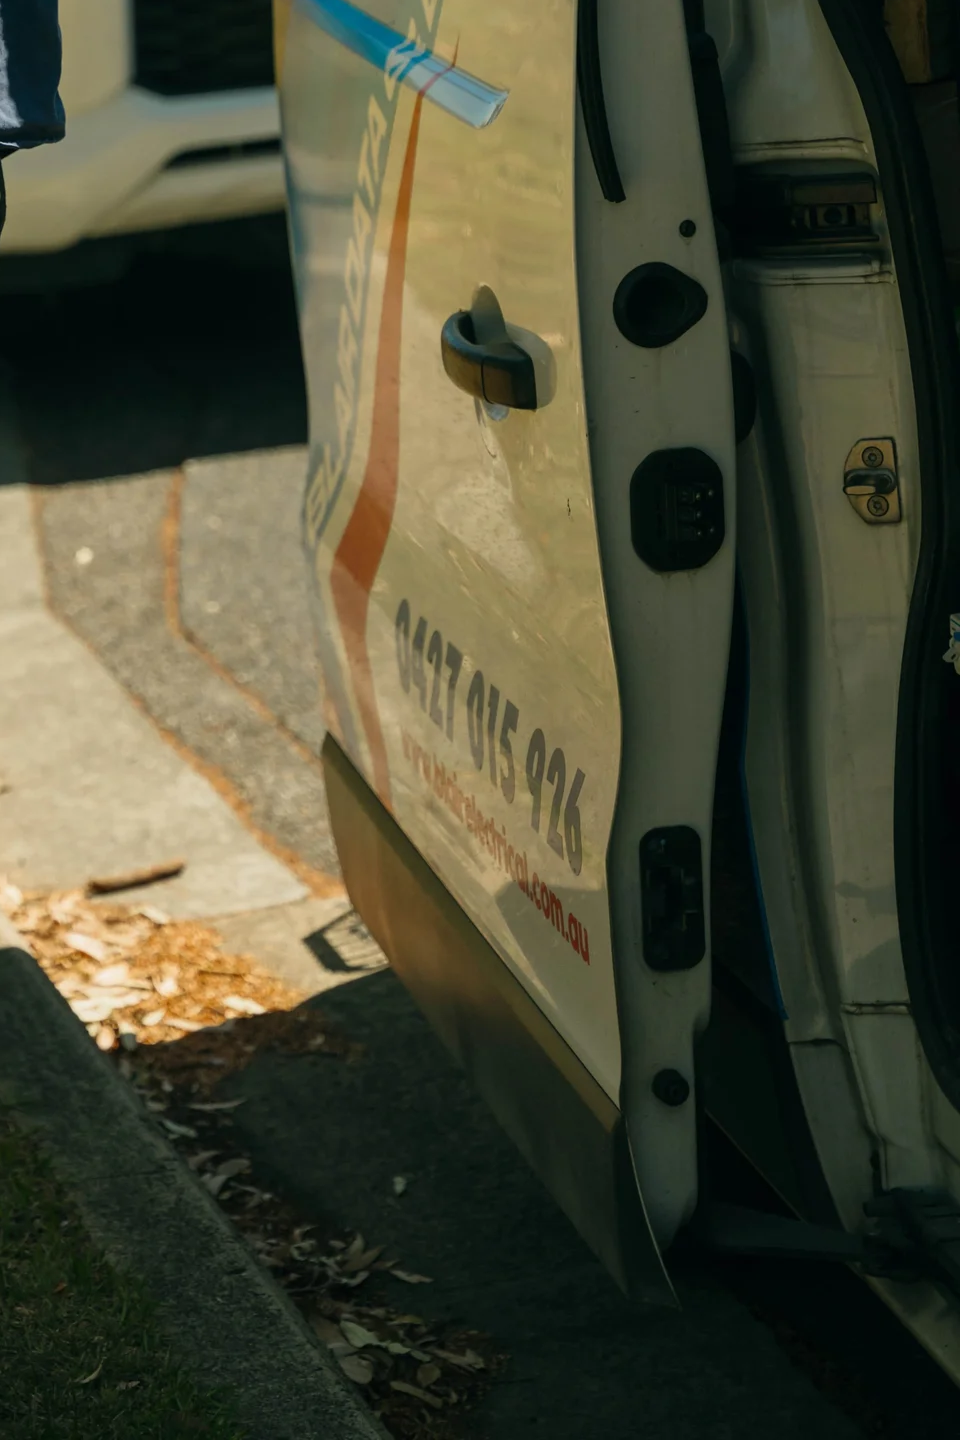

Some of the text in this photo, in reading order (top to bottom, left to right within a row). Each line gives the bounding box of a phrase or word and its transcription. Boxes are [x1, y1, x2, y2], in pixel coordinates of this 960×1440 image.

[306, 302, 357, 546] BLAIR
[344, 93, 387, 326] DATA
[395, 598, 586, 876] 0427 015 926
